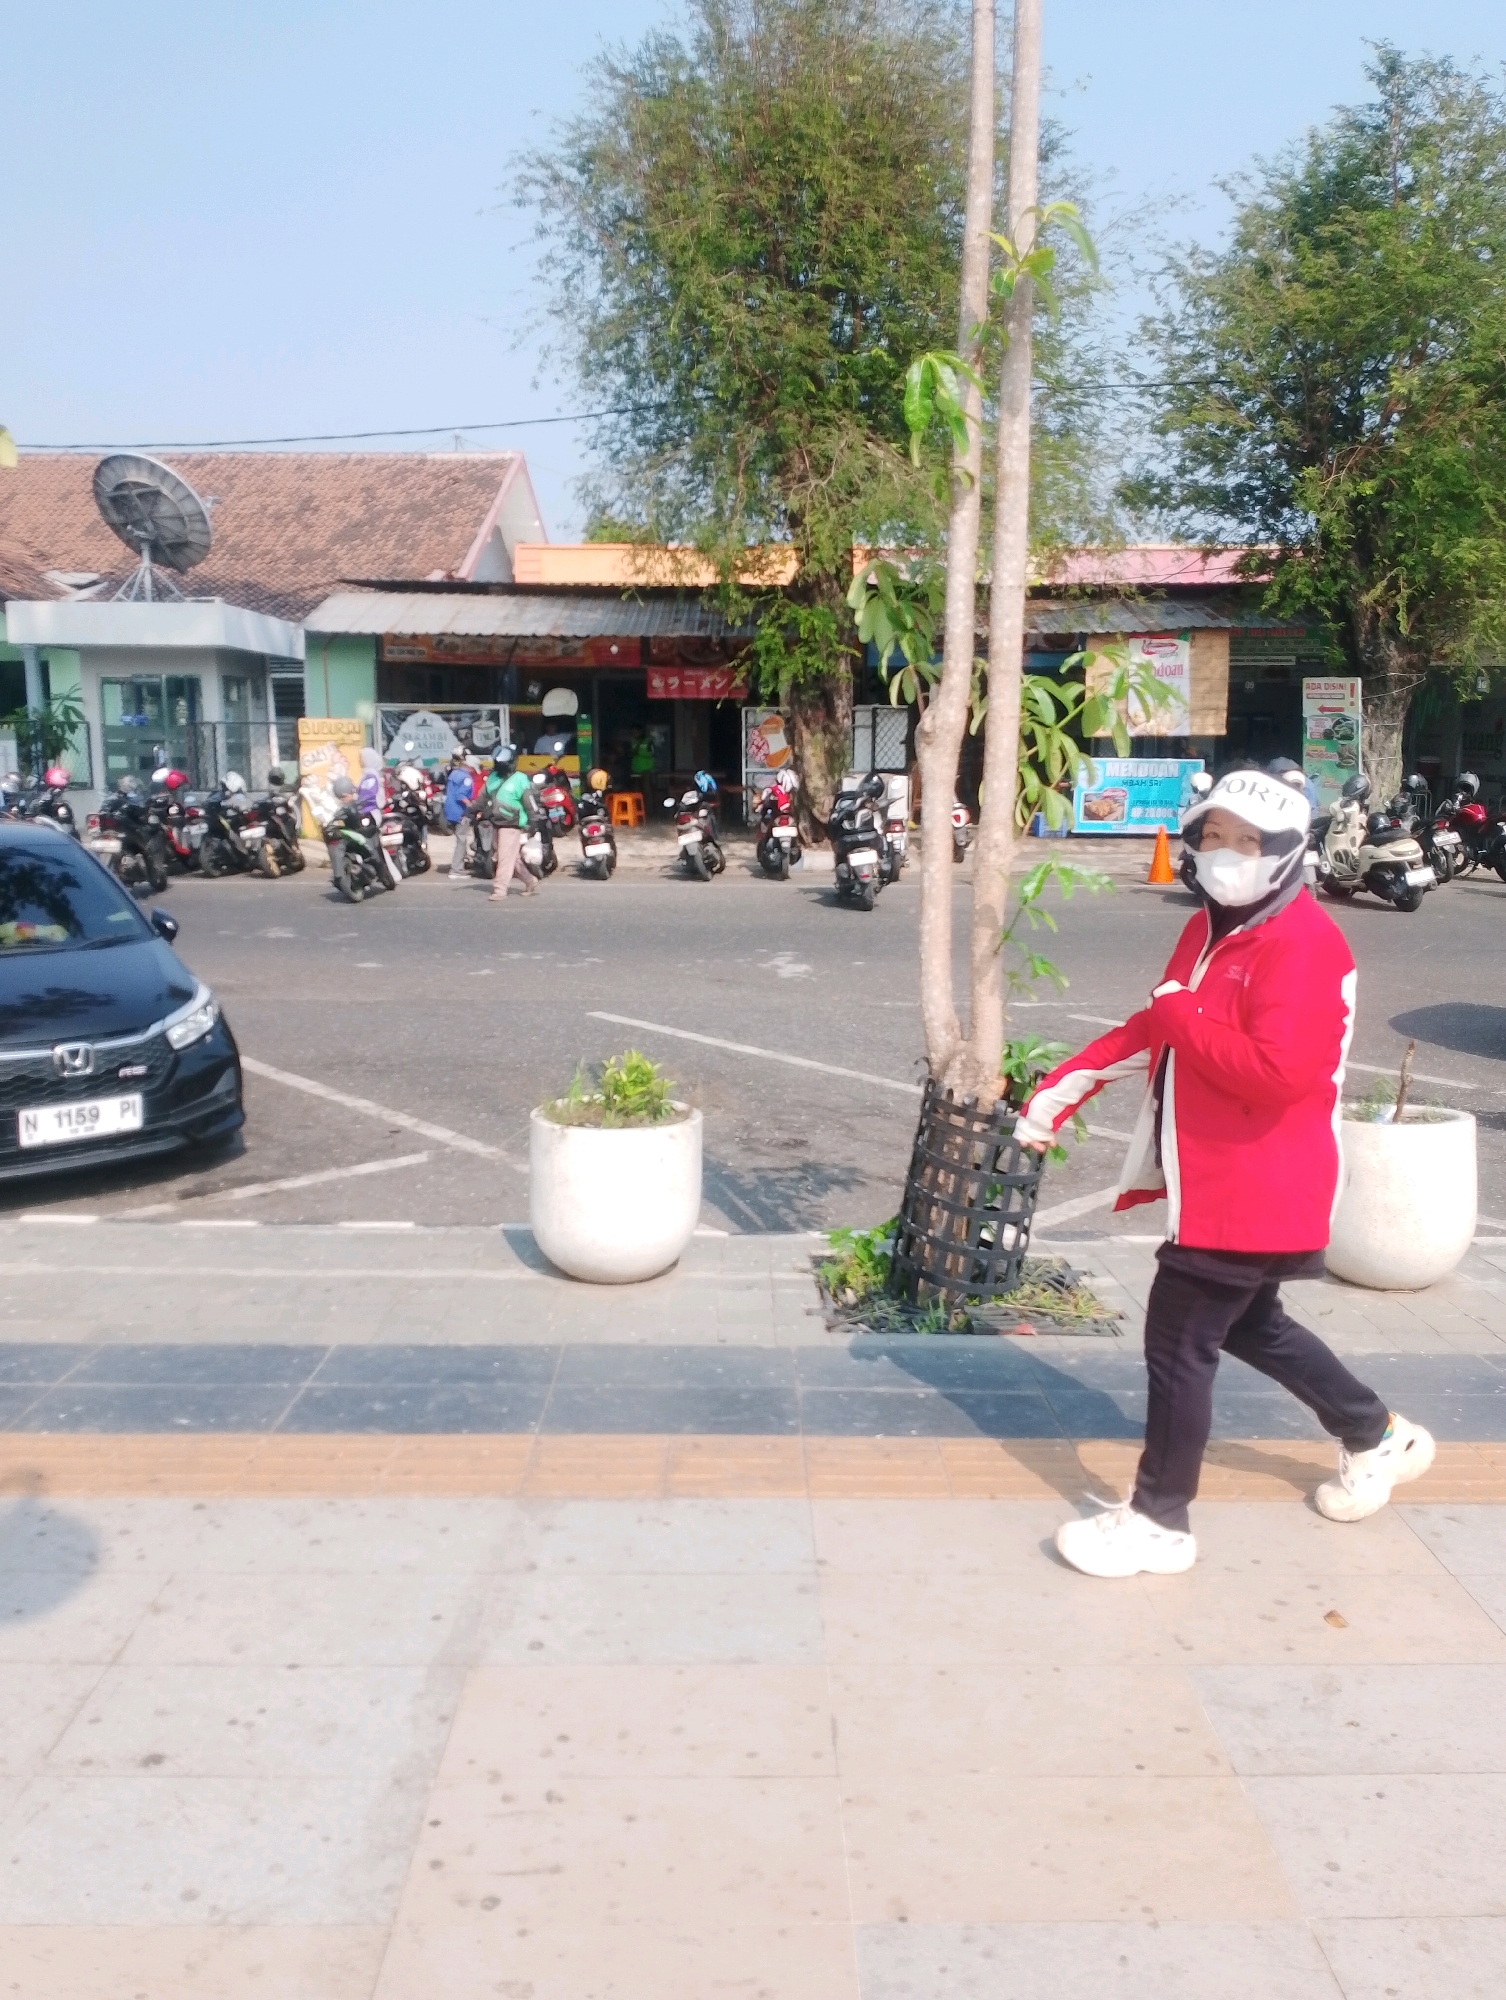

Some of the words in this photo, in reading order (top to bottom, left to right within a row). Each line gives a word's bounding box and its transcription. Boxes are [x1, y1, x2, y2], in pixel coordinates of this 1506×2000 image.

[1305, 682, 1322, 691] ADA
[1323, 682, 1347, 691] DISINI
[1106, 762, 1180, 778] MENDOAN
[24, 1113, 39, 1133] N
[53, 1104, 101, 1129] 1159
[119, 1098, 139, 1119] PI
